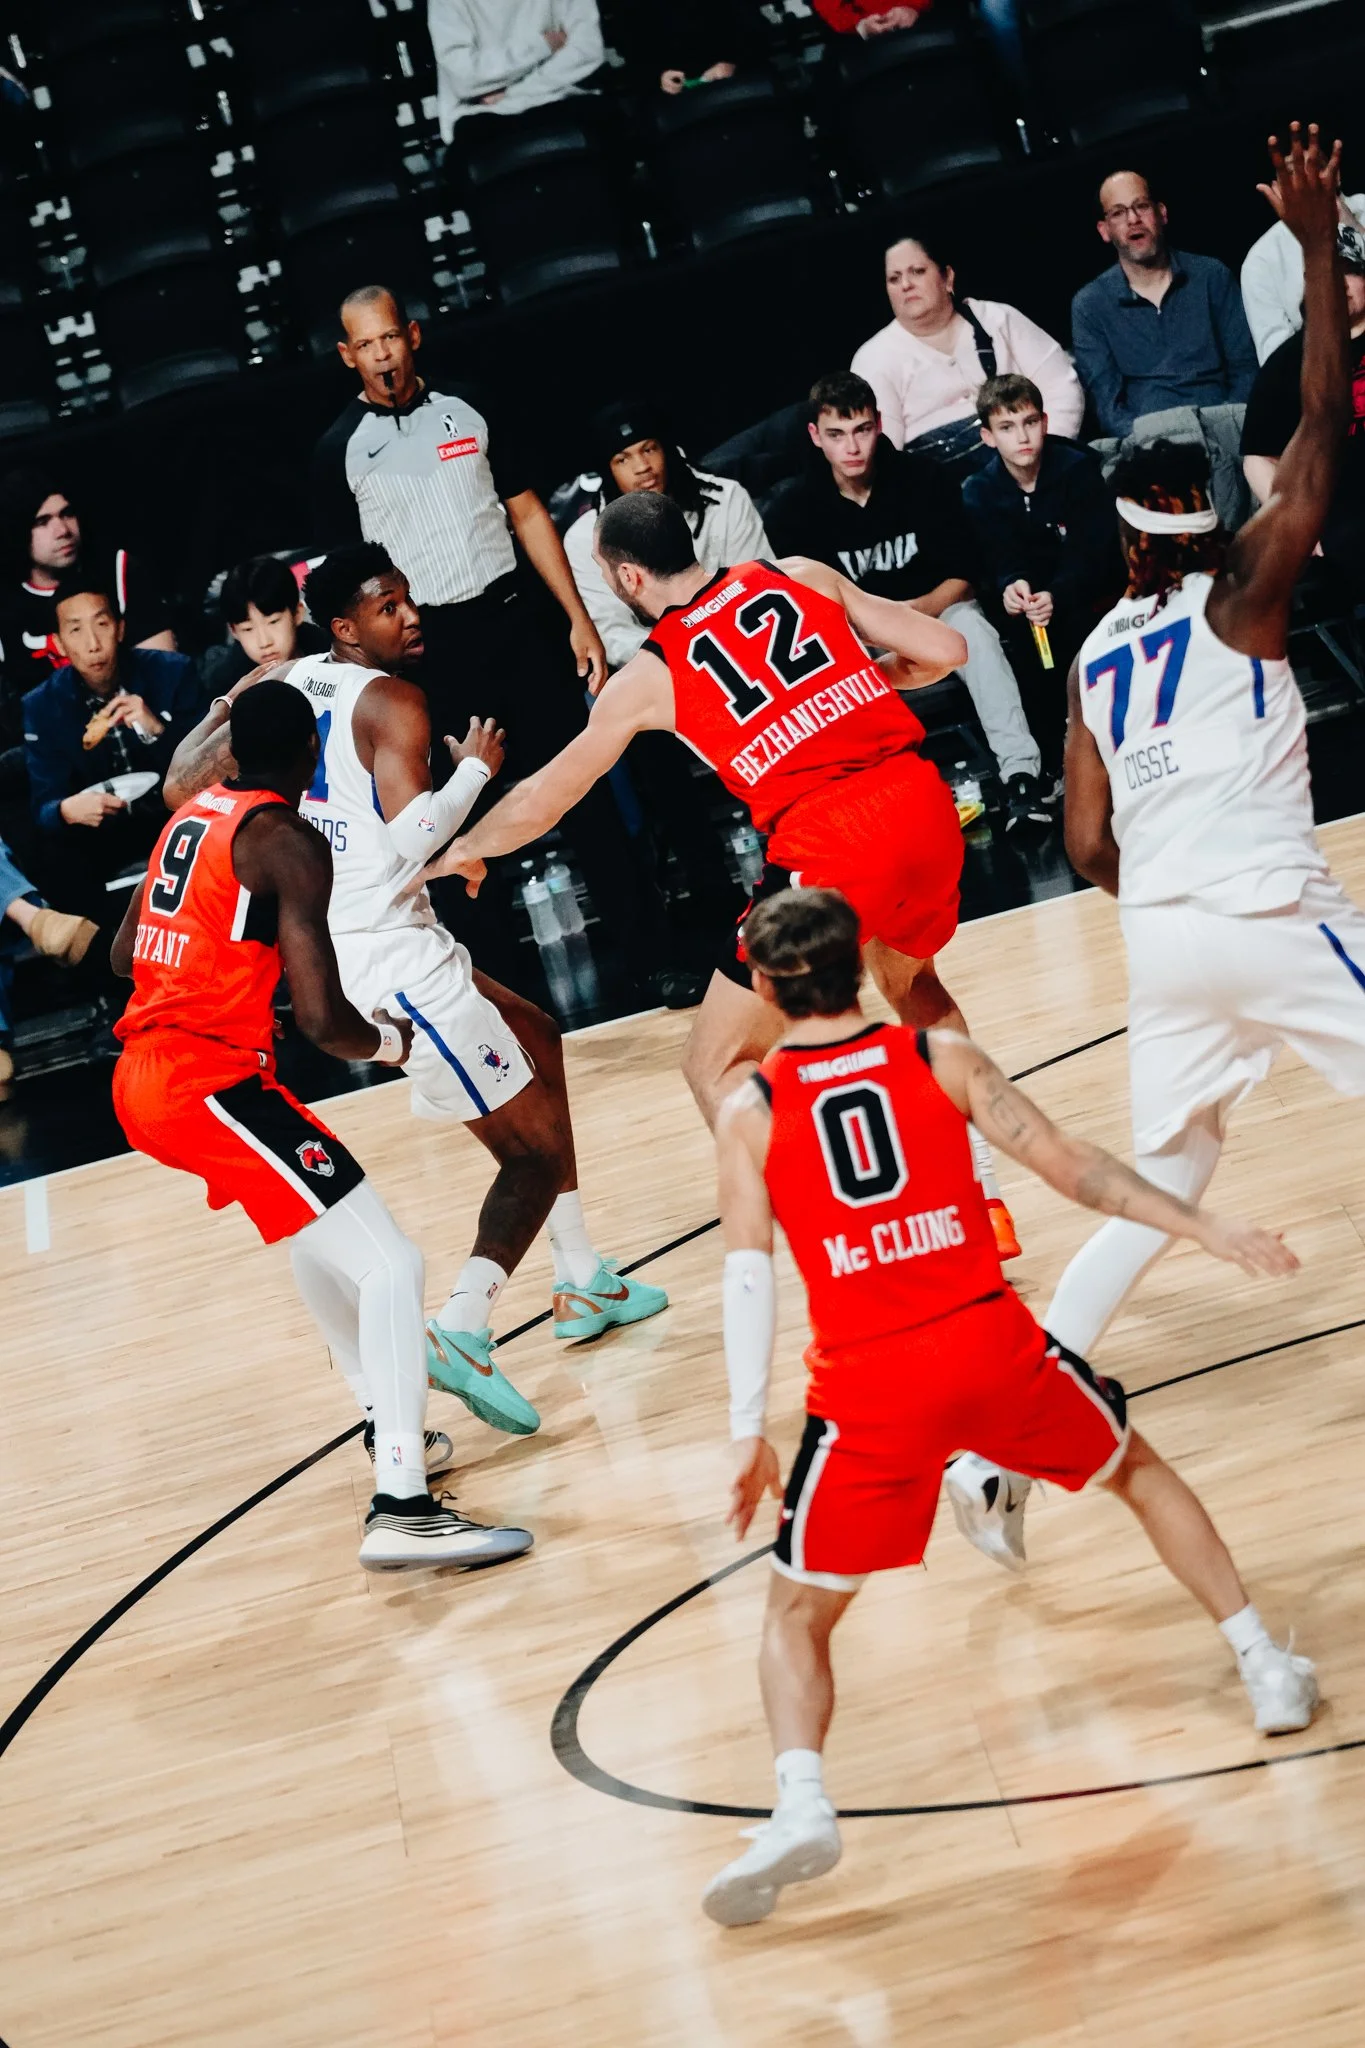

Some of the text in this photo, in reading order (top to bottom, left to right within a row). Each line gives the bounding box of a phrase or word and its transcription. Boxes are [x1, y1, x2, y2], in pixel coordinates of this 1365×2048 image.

[438, 441, 478, 458] Emirates
[686, 589, 836, 726] 12
[1085, 616, 1191, 754] 77
[730, 666, 890, 786] BEZHANISHVILI
[1124, 740, 1179, 790] CISSE
[149, 816, 211, 918] 9
[810, 1079, 909, 1209] 0
[823, 1205, 966, 1278] Mc CLUNG
